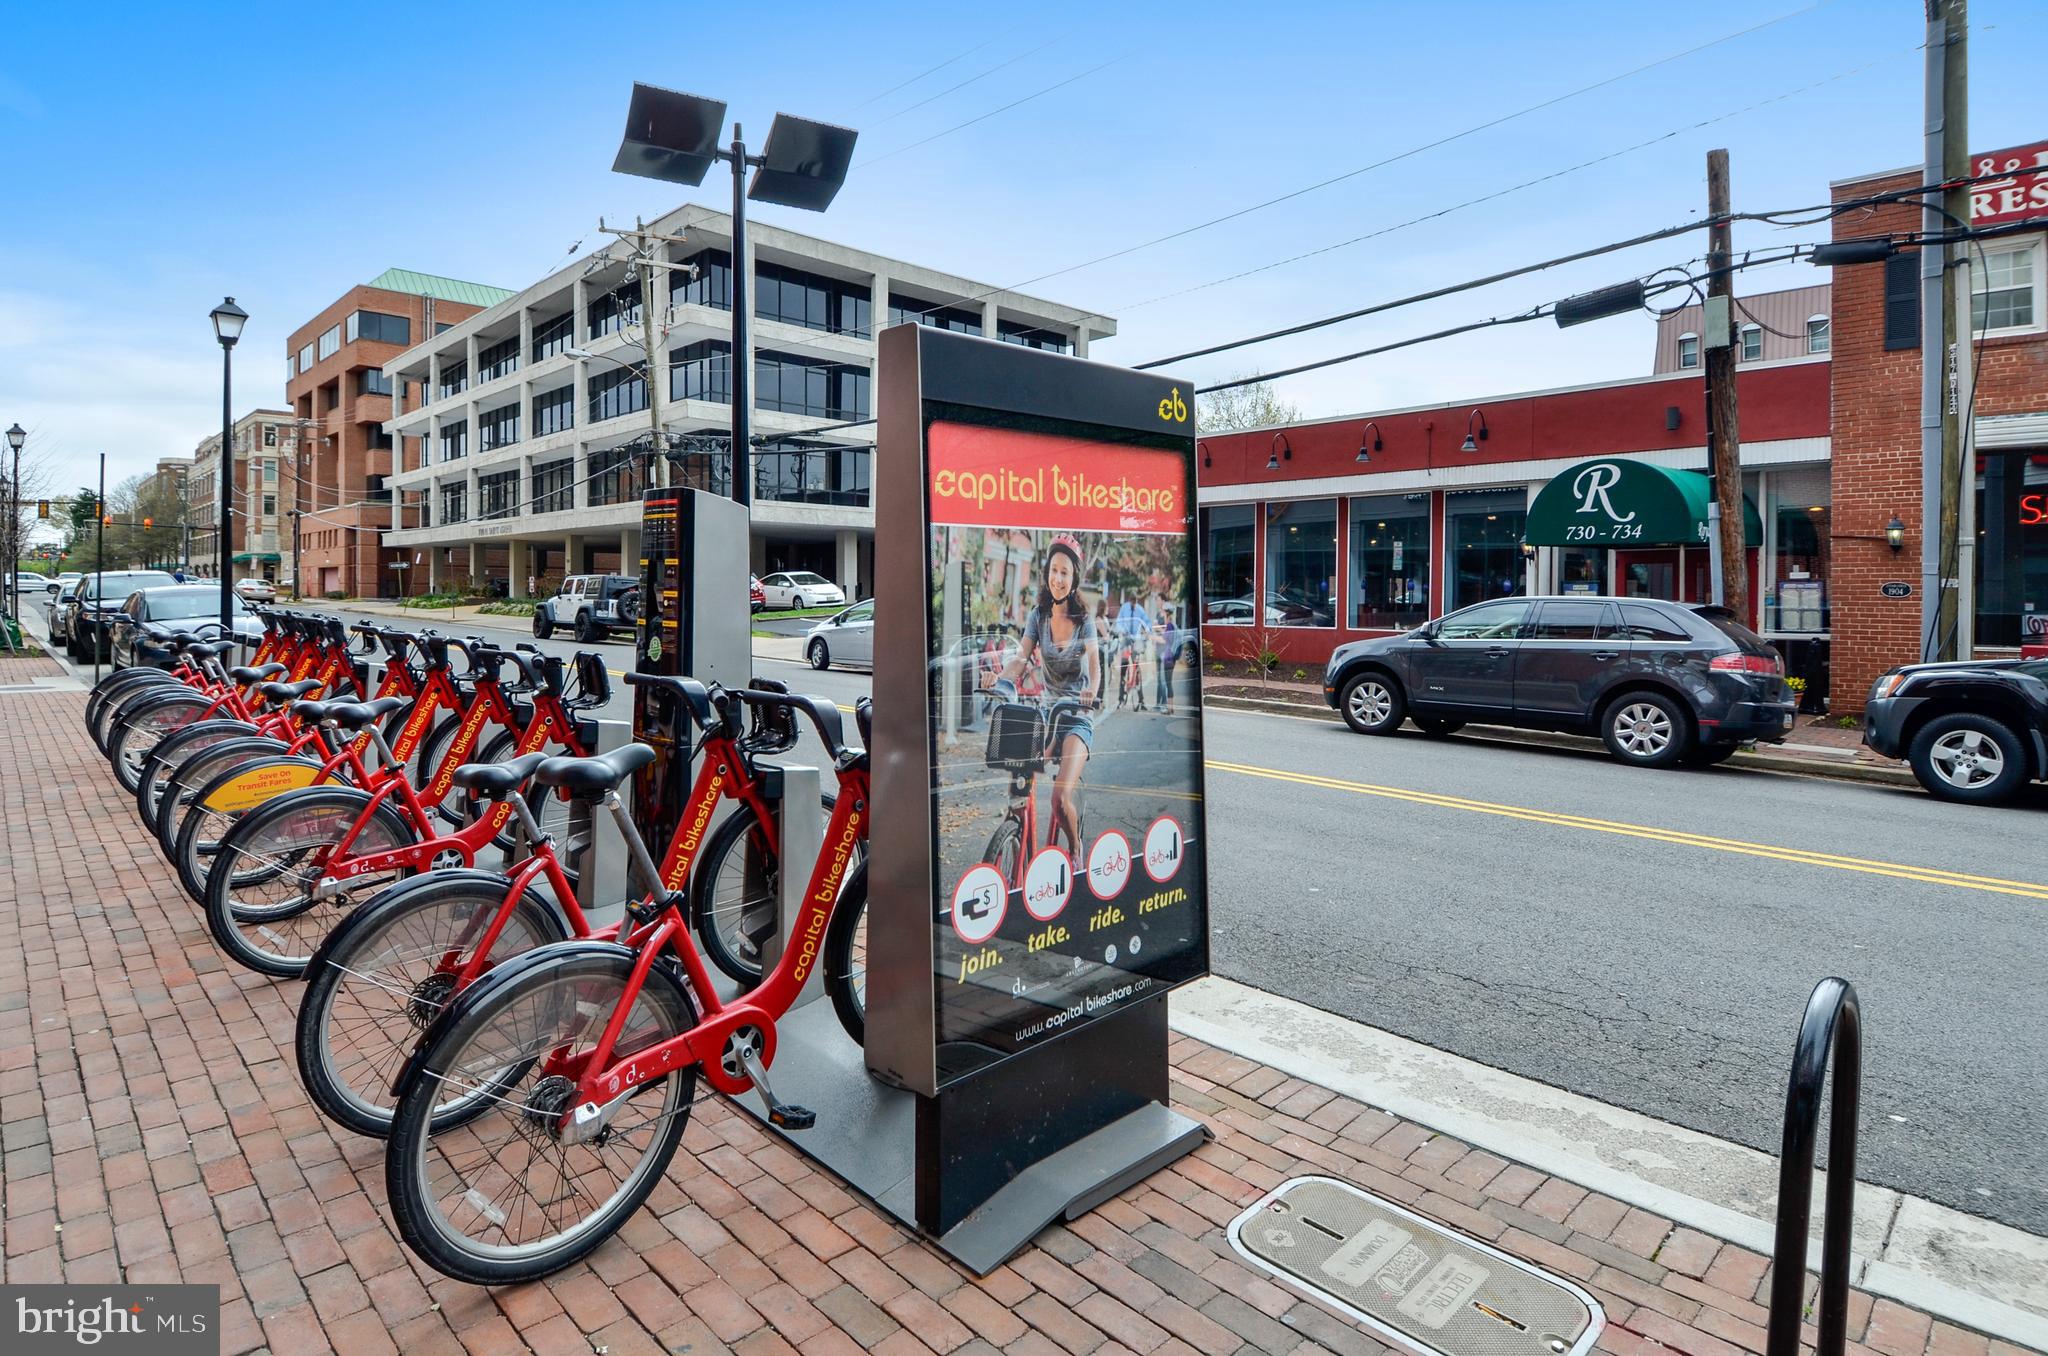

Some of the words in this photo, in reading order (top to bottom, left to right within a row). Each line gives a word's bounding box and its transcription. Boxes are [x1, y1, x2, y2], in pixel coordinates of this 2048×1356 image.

[935, 467, 1044, 510] capital
[1051, 464, 1174, 513] bikeshare
[1572, 463, 1636, 522] R
[1566, 525, 1596, 540] 730
[1611, 524, 1643, 540] 734
[1888, 587, 1904, 595] 1904
[405, 692, 438, 737] bikeshare
[435, 755, 459, 796] capital
[451, 703, 486, 754] bikeshare
[237, 780, 267, 791] Transit
[269, 778, 292, 787] Fares
[258, 772, 278, 781] Save
[667, 856, 689, 892] pital
[679, 775, 722, 851] bikeshare
[794, 908, 826, 981] capital
[815, 812, 860, 903] bikeshare
[1138, 888, 1188, 915] return.
[1089, 907, 1125, 932] ride.
[1027, 926, 1070, 952] take.
[958, 949, 1003, 984] join.
[1425, 1271, 1473, 1313] ELECTRIC
